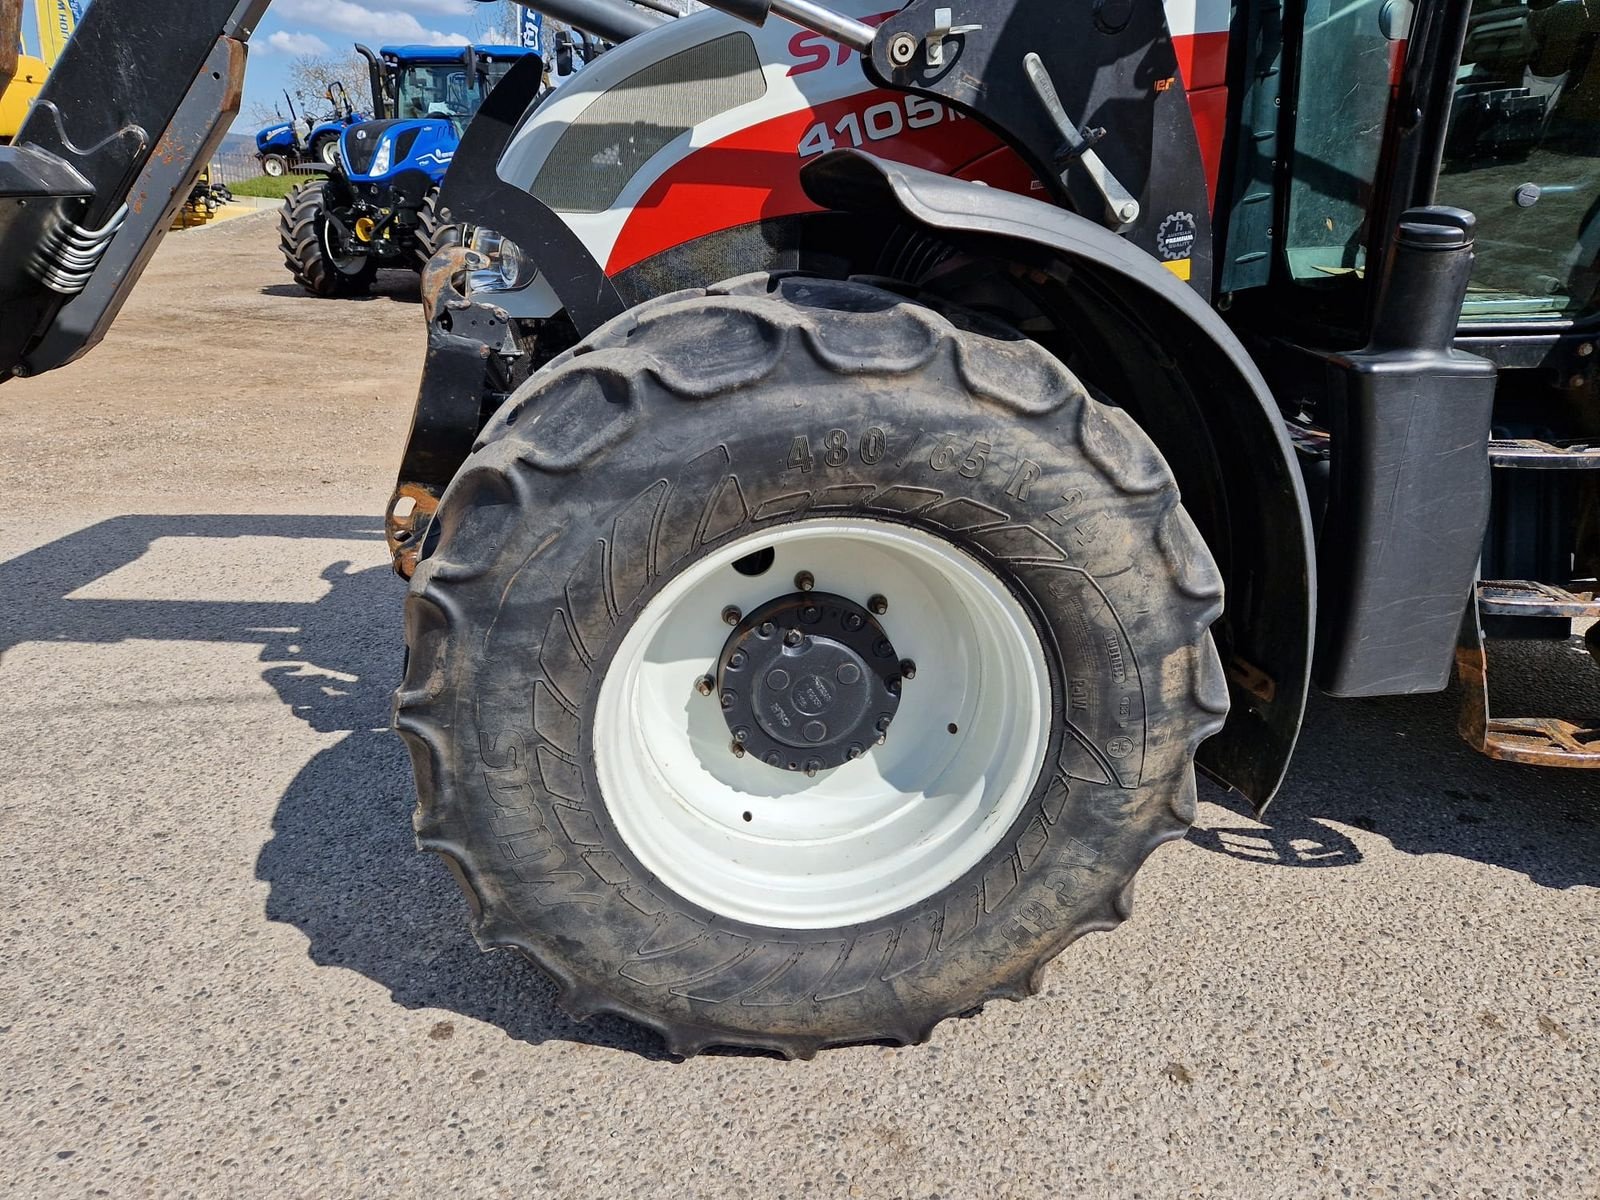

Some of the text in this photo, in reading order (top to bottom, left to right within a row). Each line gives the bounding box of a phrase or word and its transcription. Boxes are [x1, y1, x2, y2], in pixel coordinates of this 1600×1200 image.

[797, 94, 944, 158] 4105
[1165, 235, 1193, 244] PREMIUM
[1005, 458, 1042, 502] R
[478, 728, 605, 906] Mitas
